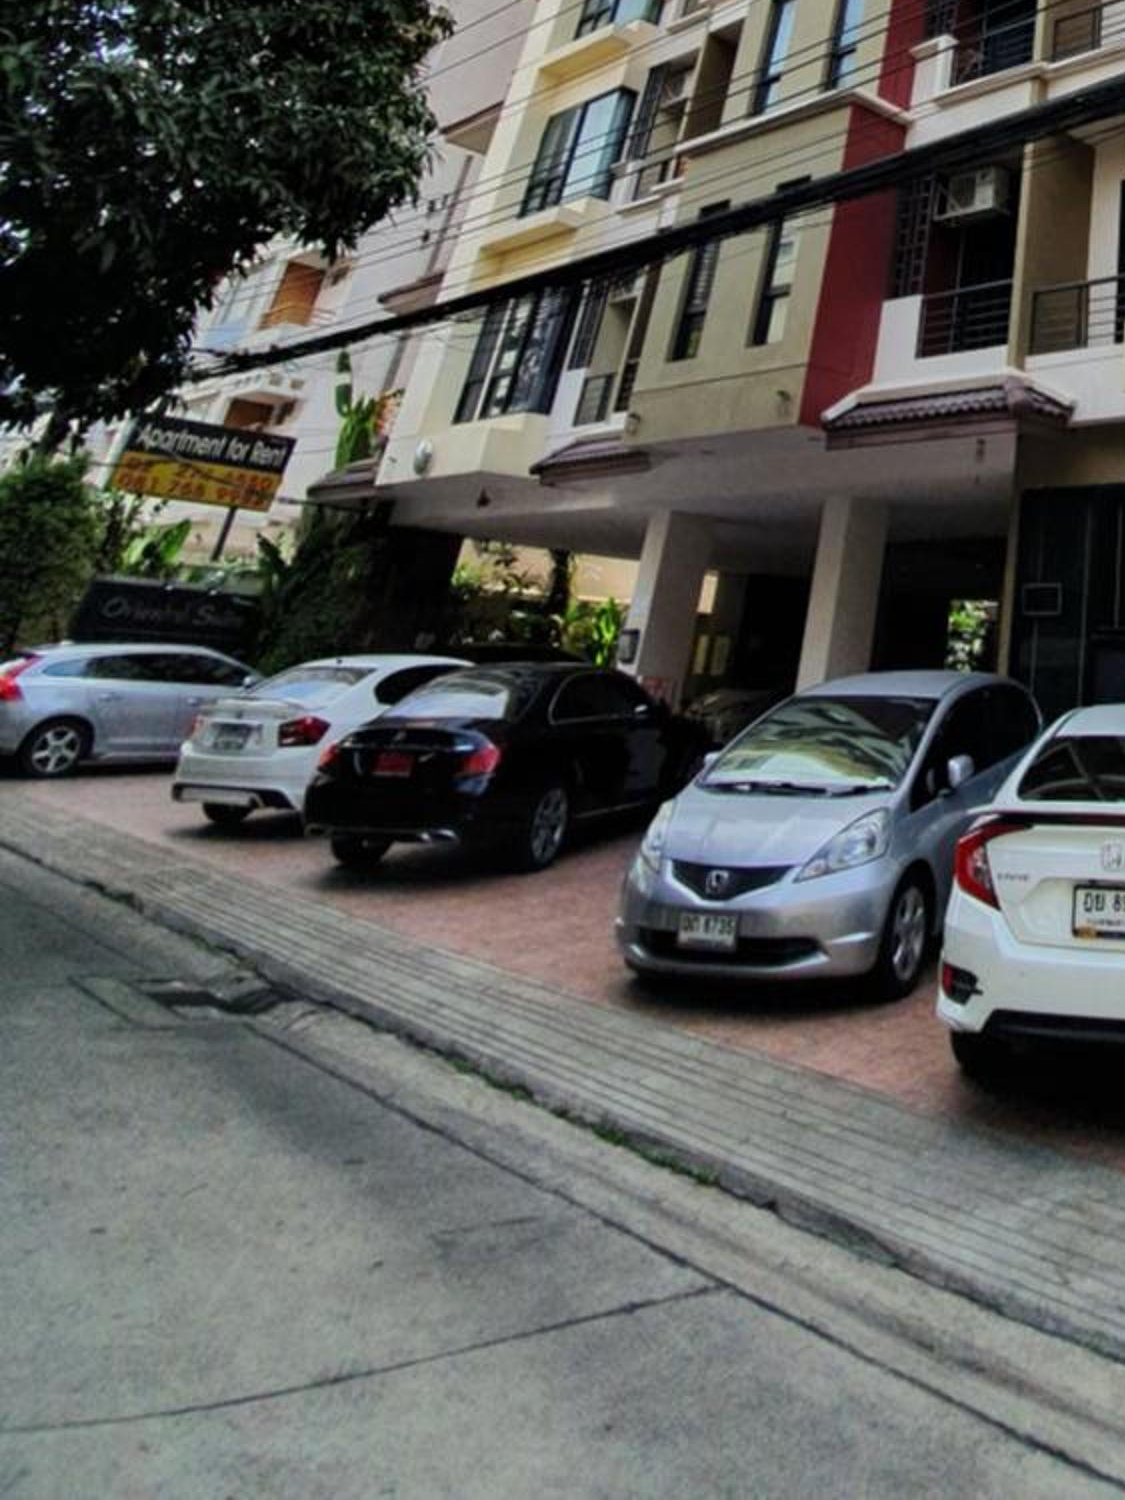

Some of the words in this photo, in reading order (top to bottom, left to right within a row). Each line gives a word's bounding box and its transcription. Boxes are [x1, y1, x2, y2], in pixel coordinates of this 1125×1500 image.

[137, 424, 225, 456] Apartment
[226, 437, 249, 458] for
[250, 440, 287, 467] Rent
